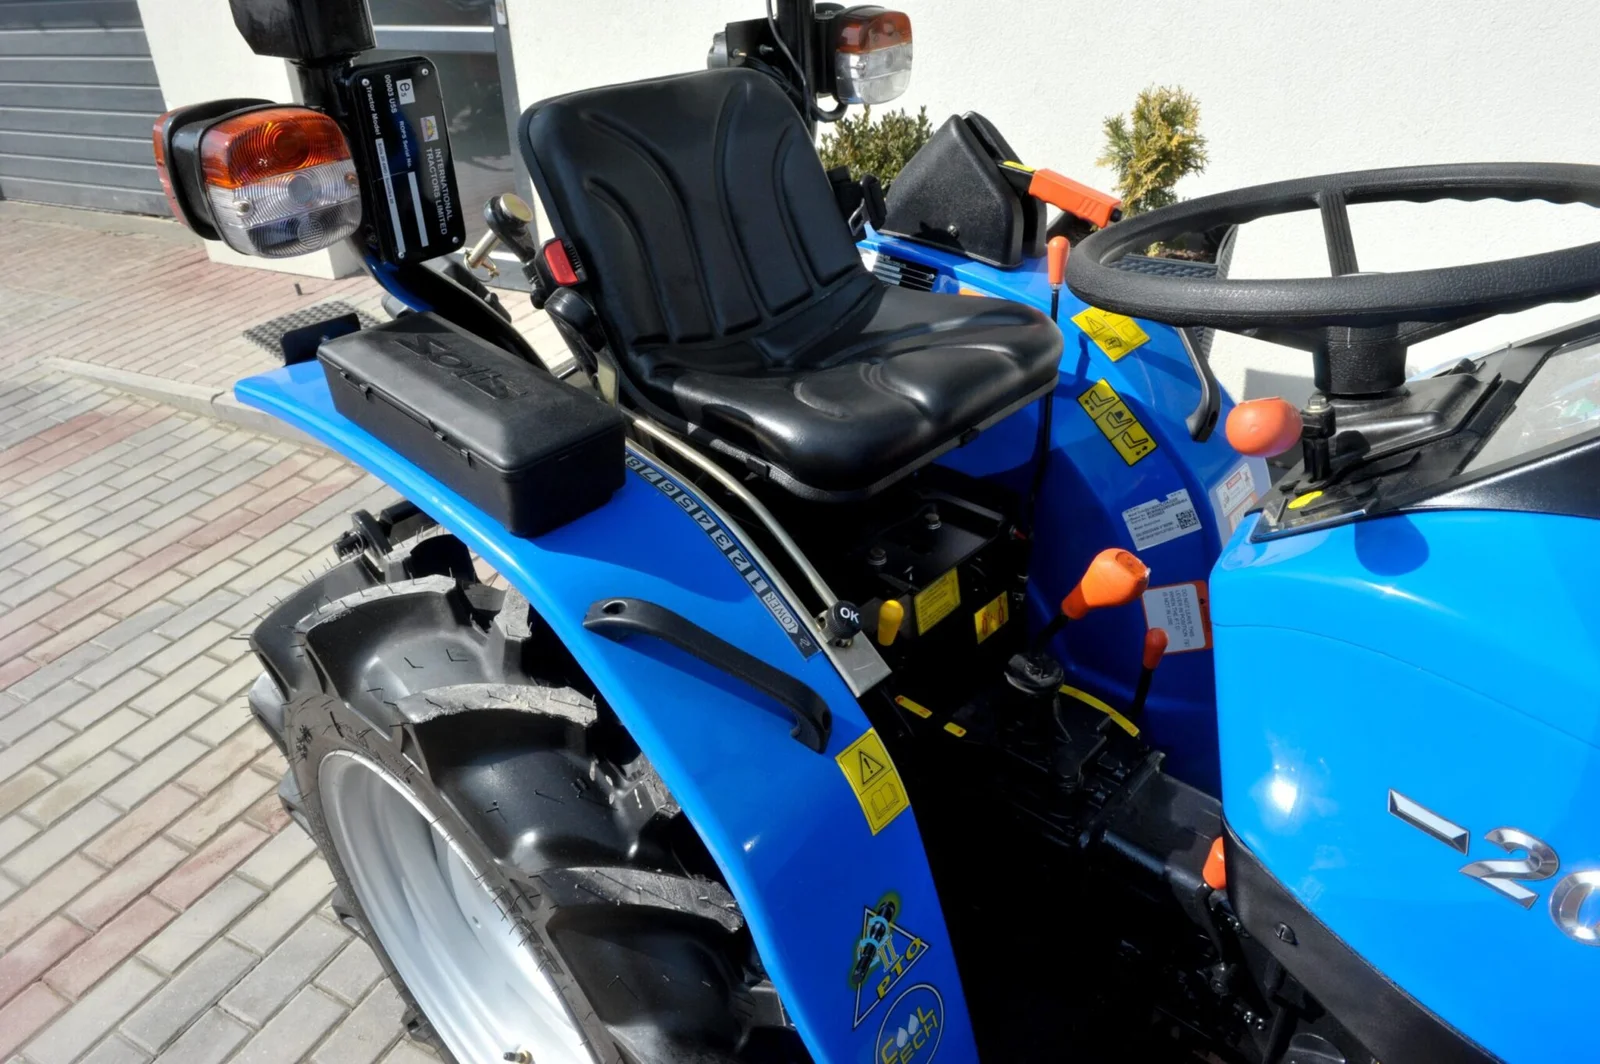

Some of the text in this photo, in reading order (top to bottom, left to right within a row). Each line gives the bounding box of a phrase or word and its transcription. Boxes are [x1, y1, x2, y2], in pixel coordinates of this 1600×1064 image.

[366, 85, 381, 136] Tractor Model
[384, 74, 394, 97] 00003
[399, 120, 408, 139] ROPS
[402, 139, 411, 157] Serial
[425, 147, 448, 236] TRACTORS LIMITED
[434, 148, 453, 221] INTERNATIONAL
[626, 458, 798, 631] LOWER 1 2 3 4 5 6 7 8
[839, 607, 860, 624] OK
[876, 937, 922, 999] PTO
